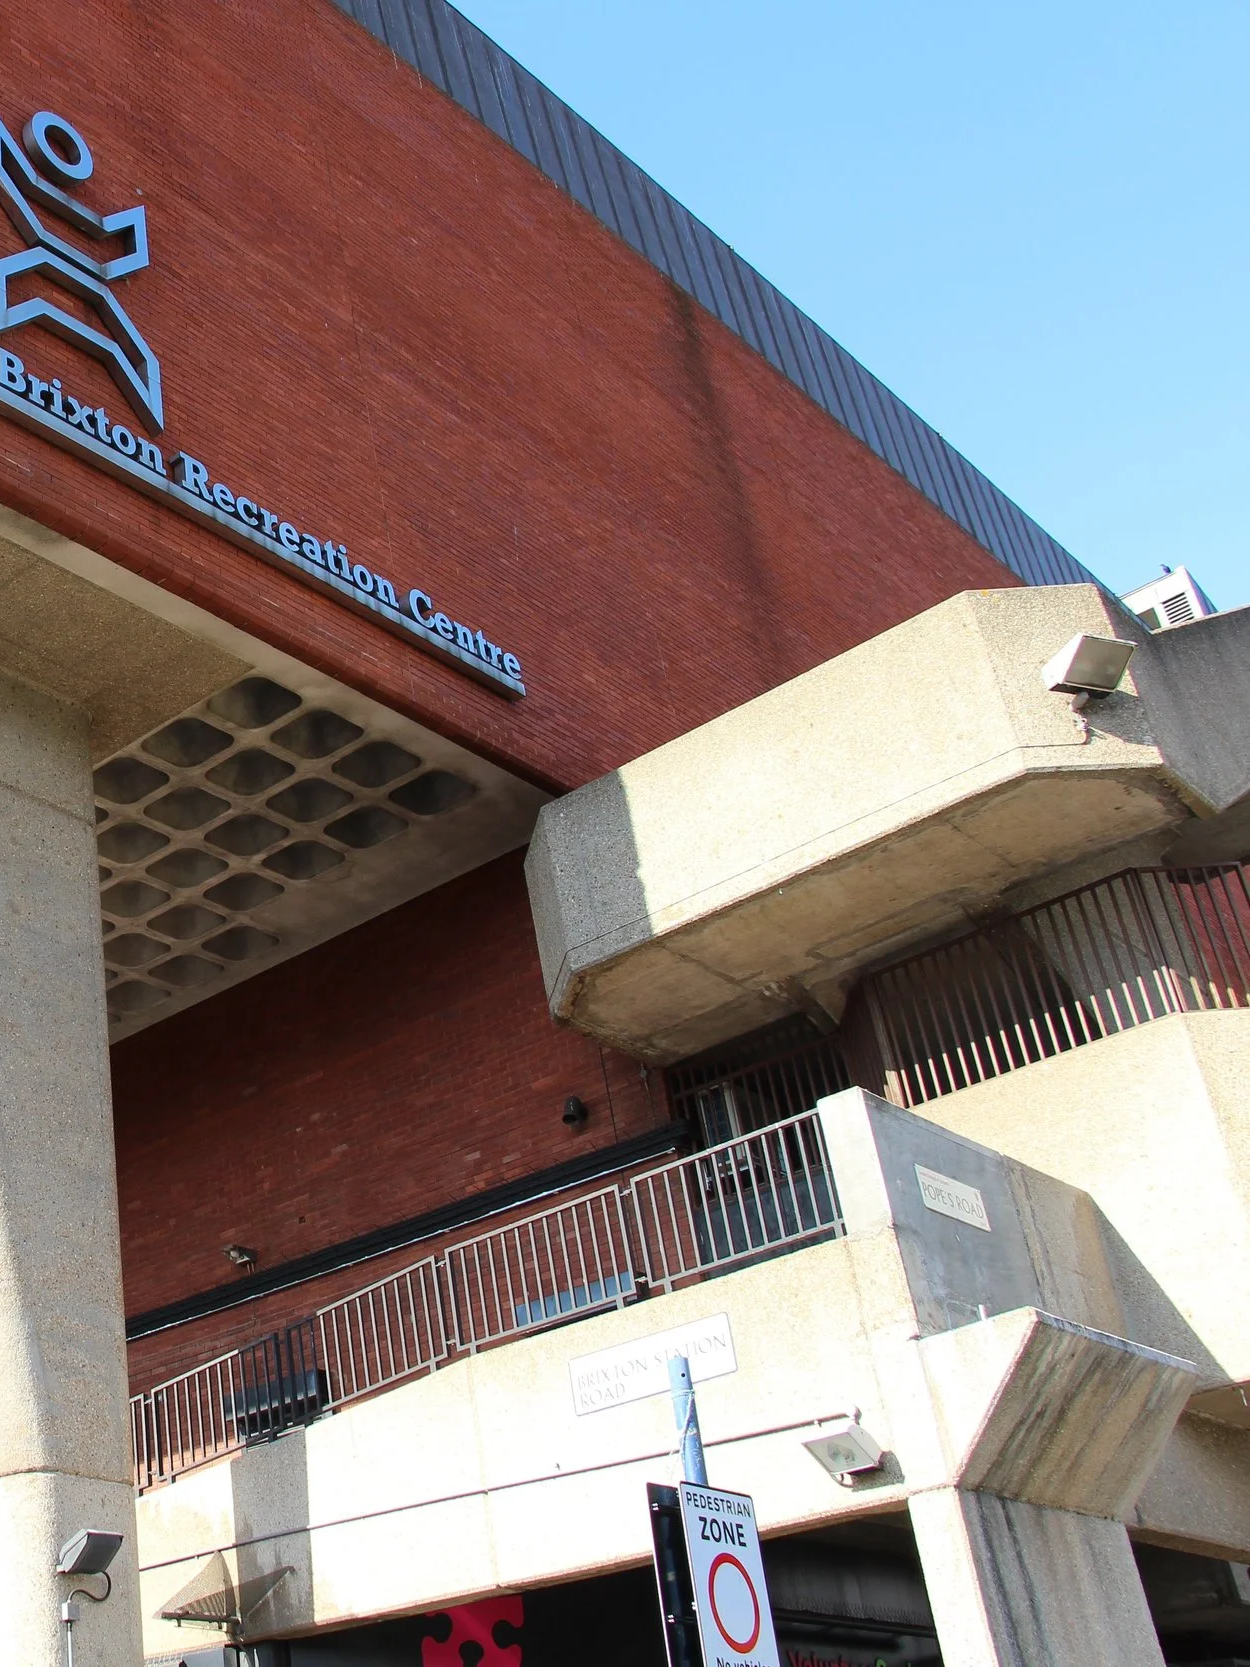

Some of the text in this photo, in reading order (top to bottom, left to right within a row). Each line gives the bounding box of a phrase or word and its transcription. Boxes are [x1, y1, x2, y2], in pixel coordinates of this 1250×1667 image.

[175, 453, 400, 607] Recreation
[404, 592, 523, 680] Centre
[921, 1181, 984, 1219] POPE'S ROAD
[578, 1333, 726, 1389] BRIXTON STATION
[580, 1383, 625, 1408] ROAD
[686, 1491, 751, 1518] PEDESTRIAN
[698, 1516, 747, 1547] ZONE
